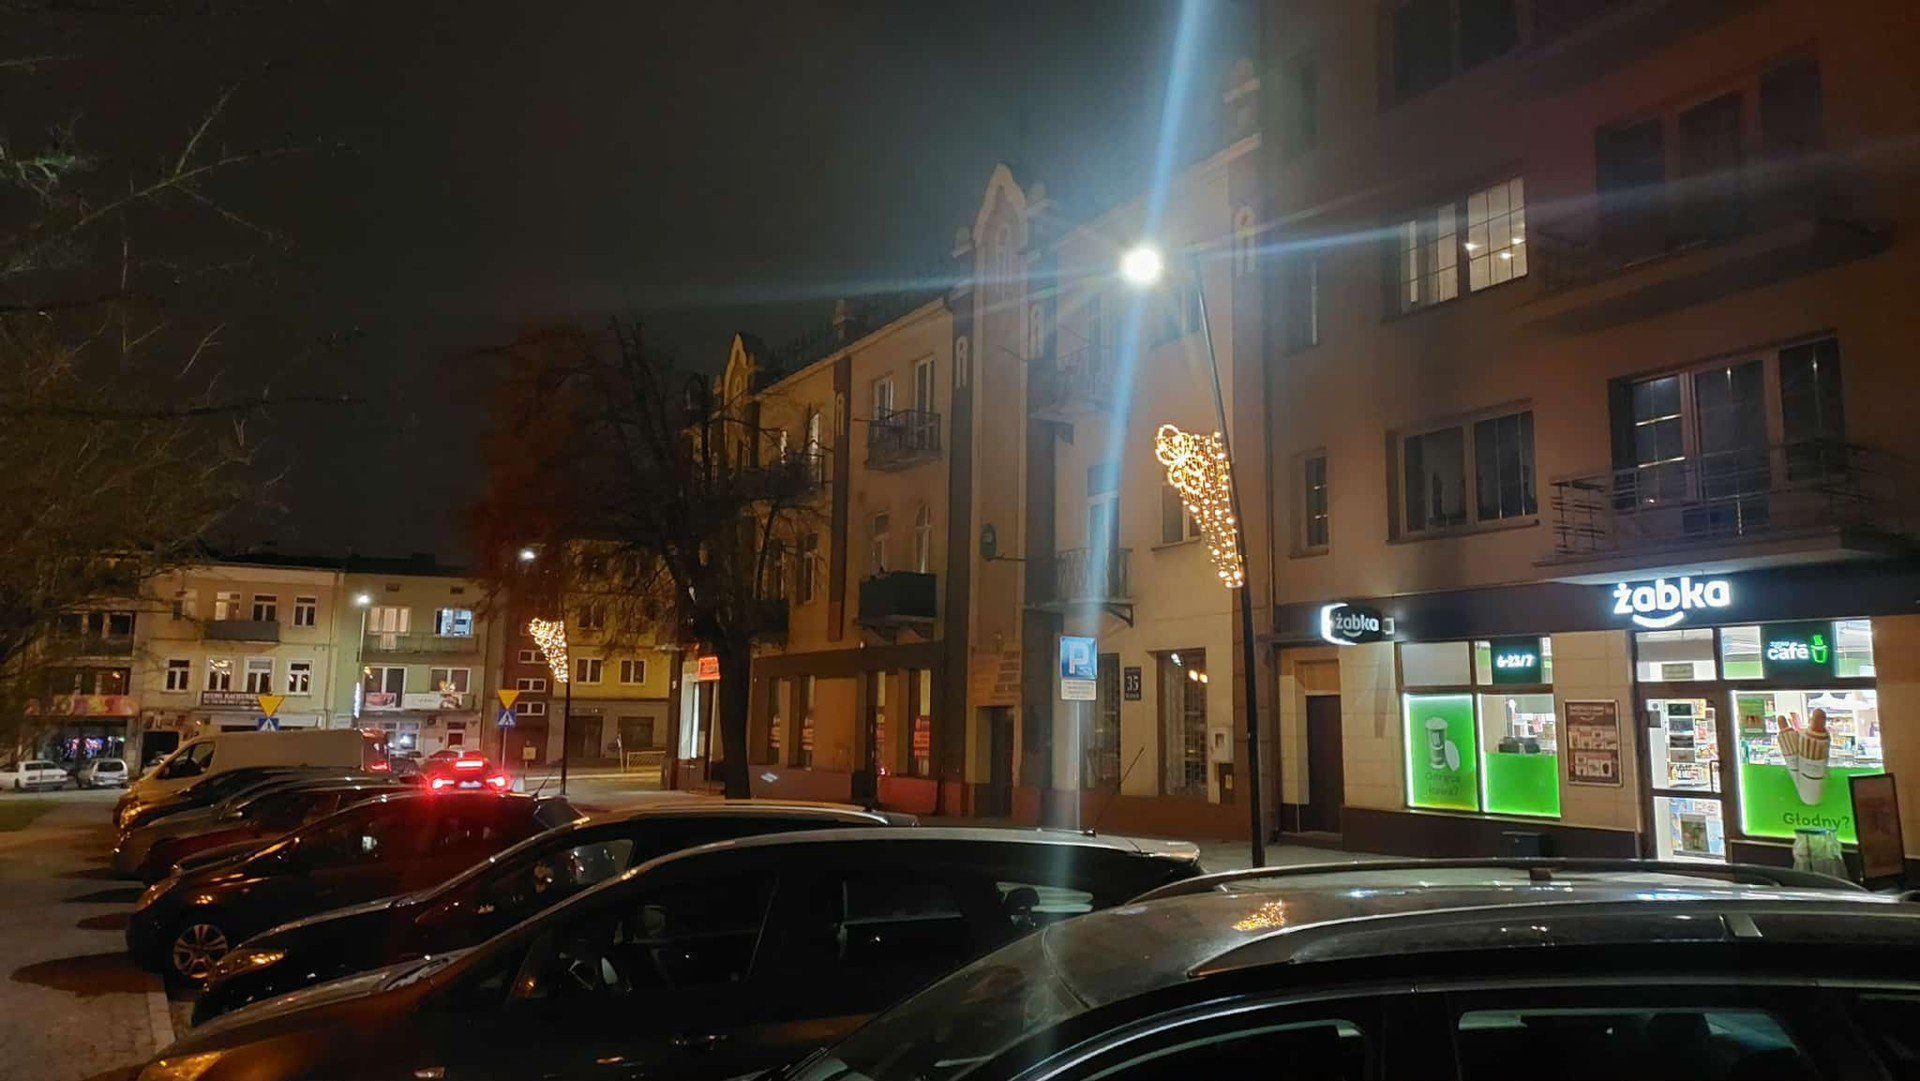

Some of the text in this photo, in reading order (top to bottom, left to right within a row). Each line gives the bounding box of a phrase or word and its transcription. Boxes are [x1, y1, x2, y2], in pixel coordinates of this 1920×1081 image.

[1613, 576, 1730, 614] żabka
[1335, 613, 1379, 631] żabka
[1069, 642, 1090, 675] P
[1126, 675, 1139, 691] 35
[1783, 812, 1850, 829] Głodny?
